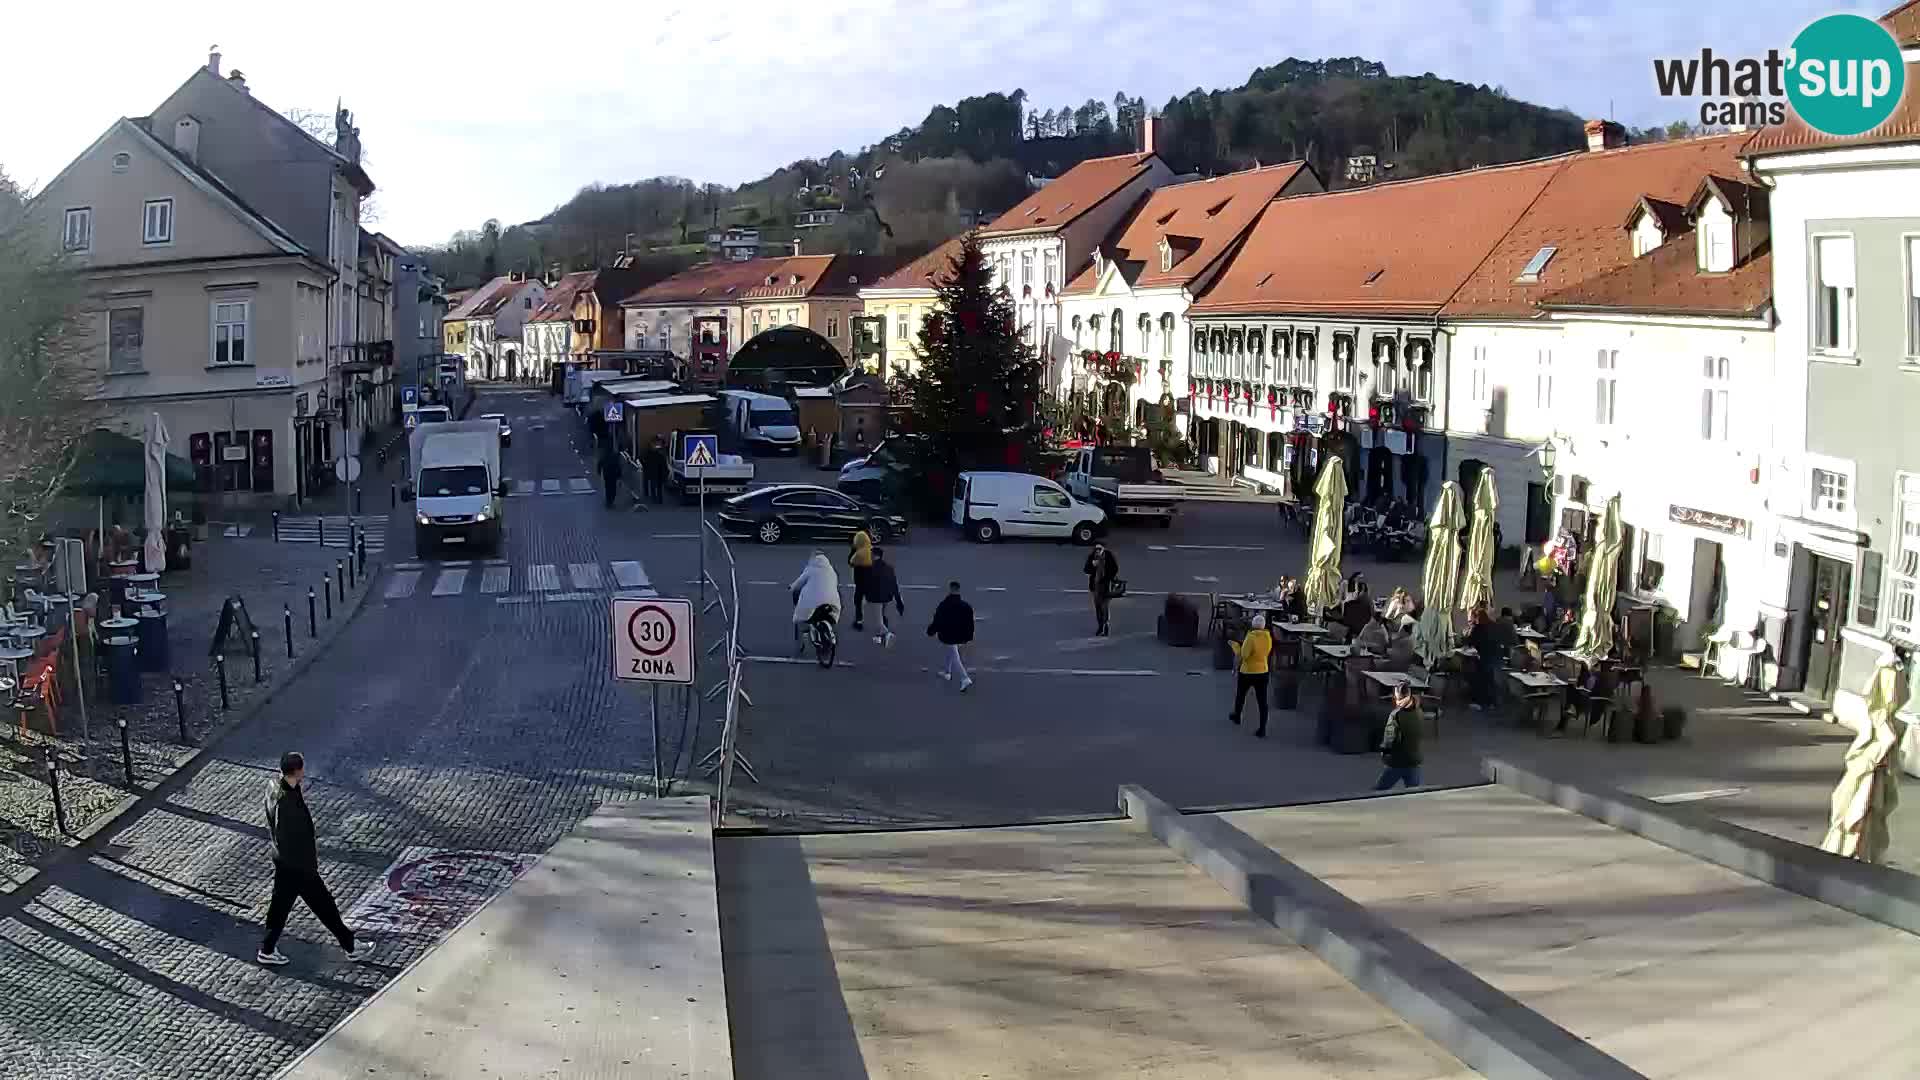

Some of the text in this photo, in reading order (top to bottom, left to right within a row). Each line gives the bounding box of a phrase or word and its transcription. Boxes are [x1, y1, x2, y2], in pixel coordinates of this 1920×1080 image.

[406, 390, 414, 401] P
[641, 621, 665, 641] 30
[631, 658, 675, 675] ZONA
